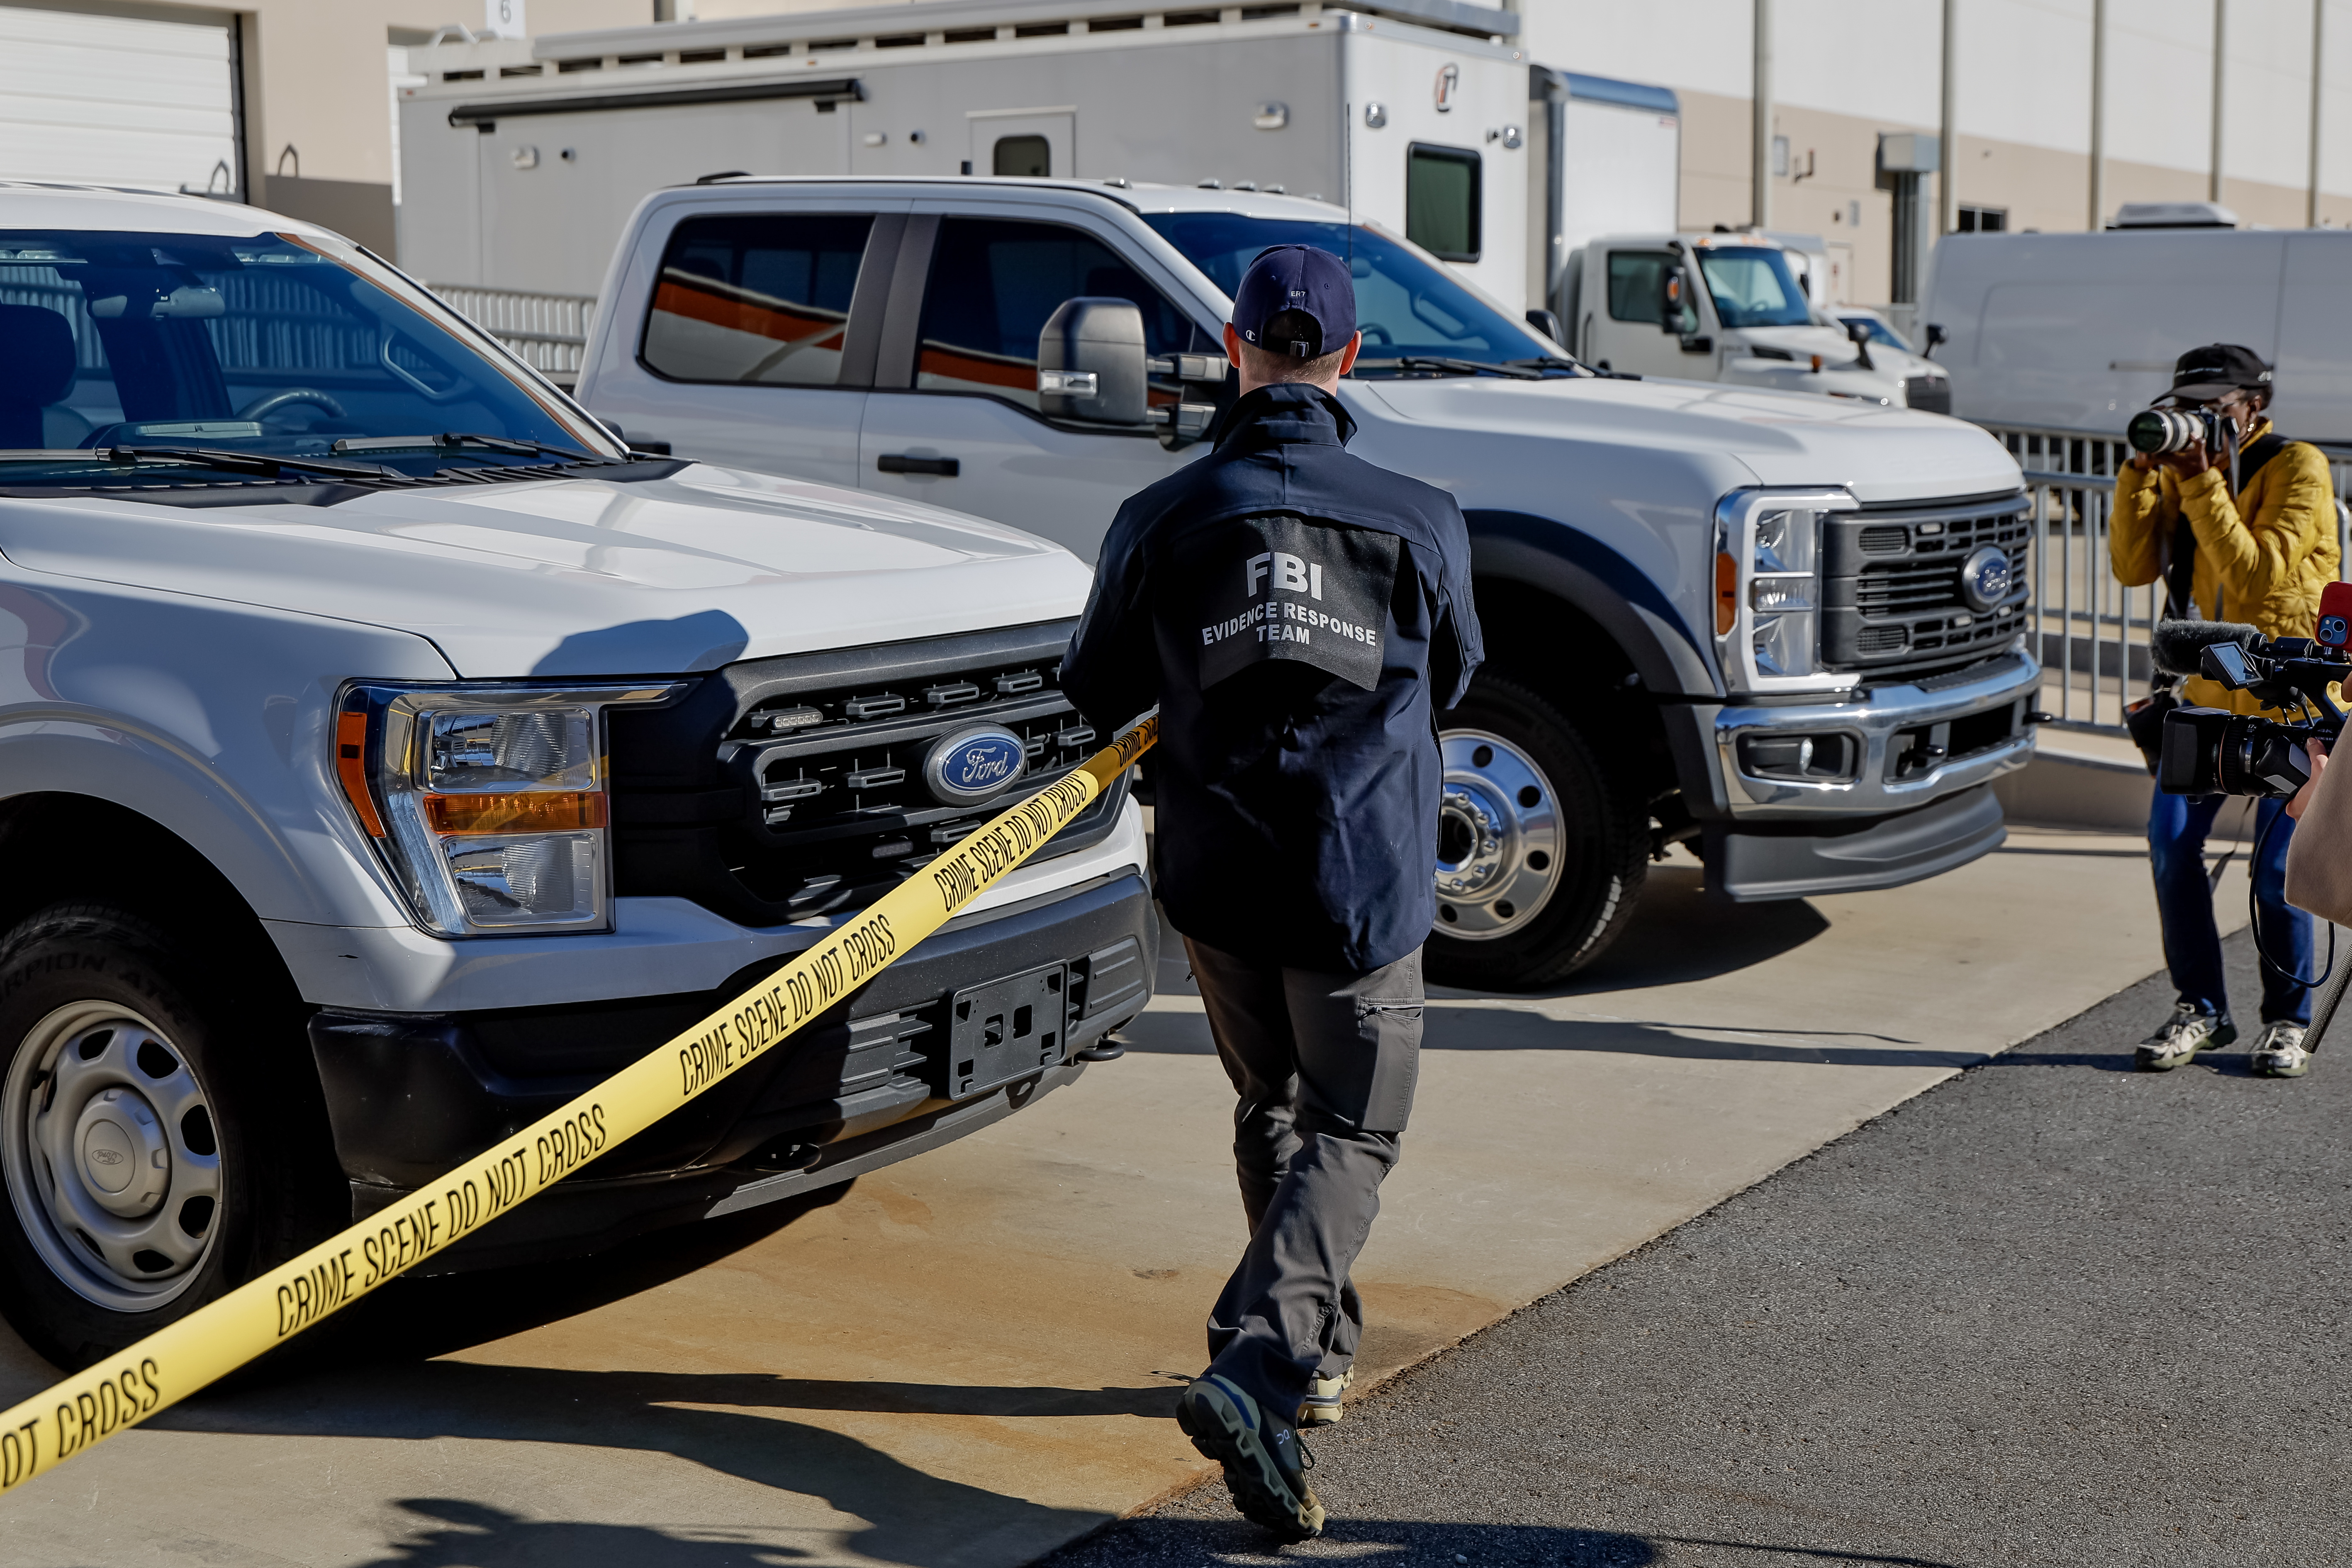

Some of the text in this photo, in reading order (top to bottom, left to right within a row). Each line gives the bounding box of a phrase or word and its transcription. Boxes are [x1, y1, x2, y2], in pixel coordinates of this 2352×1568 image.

[501, 0, 511, 24] 6
[1247, 552, 1322, 601] FBI
[1202, 602, 1376, 646] EVIDENCE RESPONSE
[1256, 624, 1310, 645] TEAM
[962, 747, 1008, 782] Ford
[1108, 717, 1158, 767] CRIME SCE
[934, 774, 1087, 912] CRIME SCENE DO NOT CROSS
[679, 913, 896, 1096] CRIME SCENE DO NOT CROSS
[97, 1151, 117, 1164] Ford
[277, 1103, 607, 1337] CRIME SCENE DO NOT CROSS
[2, 1357, 162, 1487] OT CROSS
